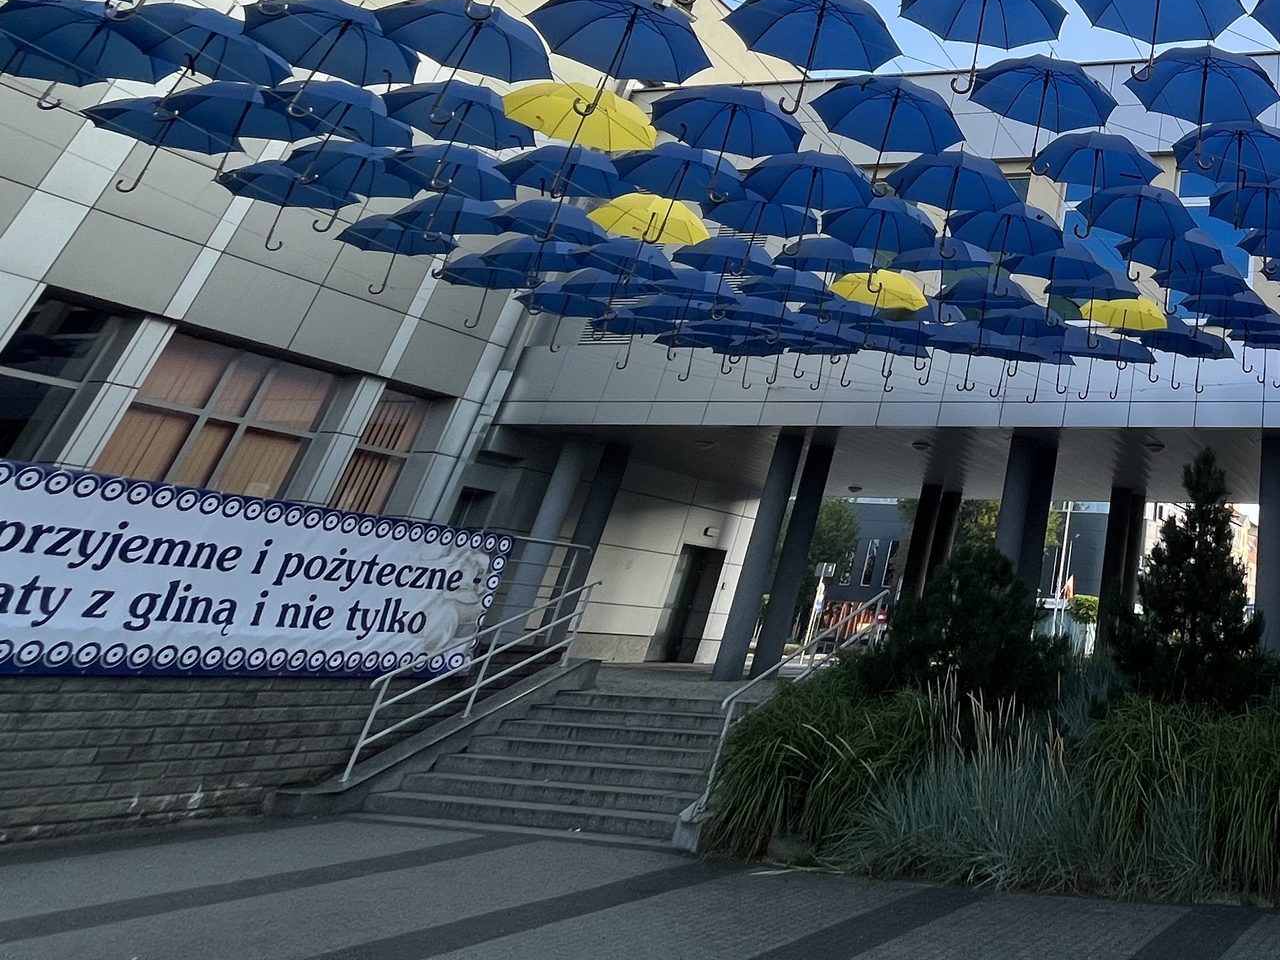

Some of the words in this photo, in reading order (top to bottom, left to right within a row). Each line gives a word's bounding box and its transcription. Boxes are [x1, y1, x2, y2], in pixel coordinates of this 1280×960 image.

[251, 539, 274, 575] i
[272, 548, 464, 591] pożyteczne
[81, 590, 115, 619] z
[123, 579, 238, 637] gliną
[250, 590, 269, 627] i
[275, 594, 335, 631] nie
[346, 597, 427, 641] tylko
